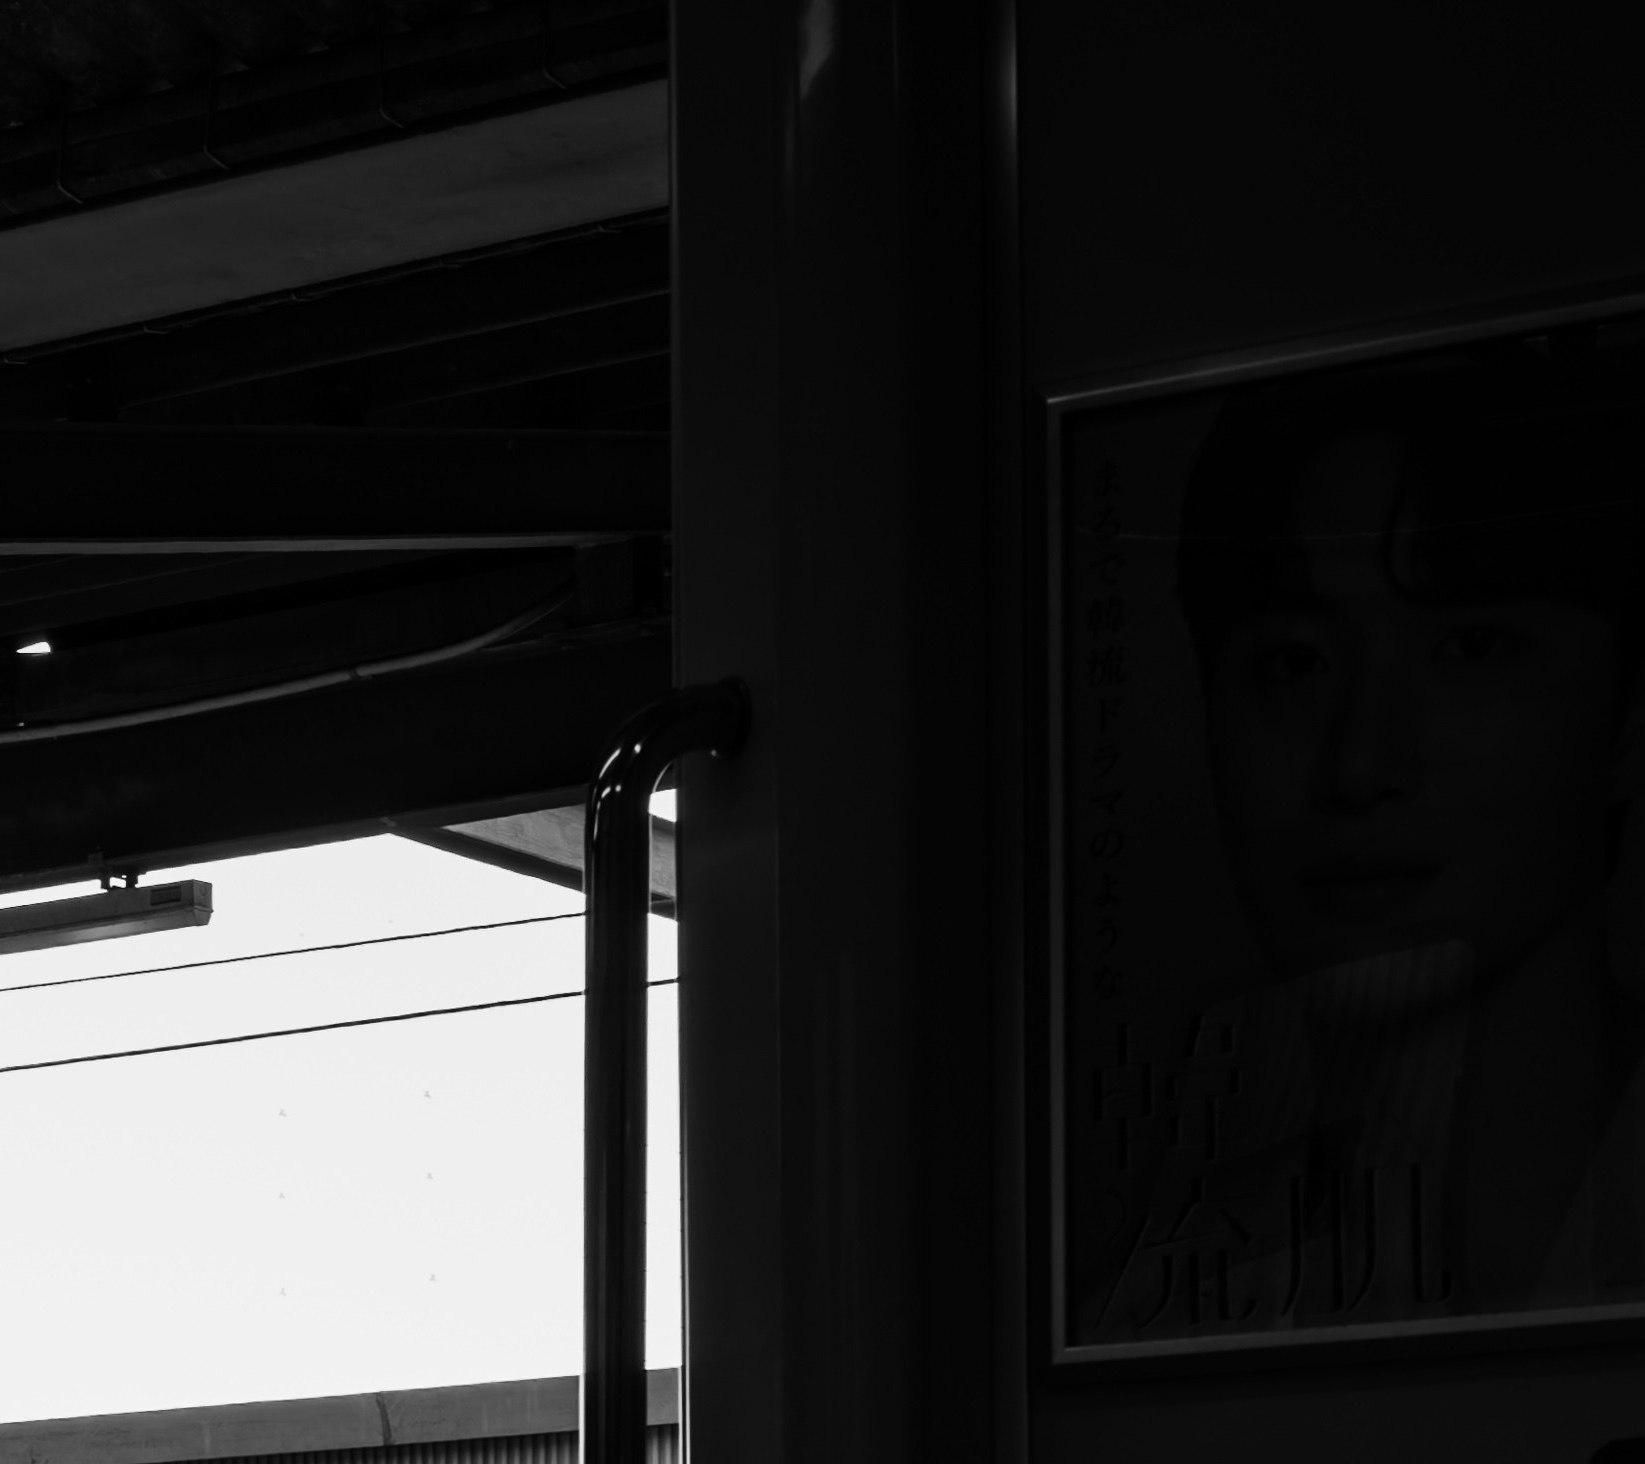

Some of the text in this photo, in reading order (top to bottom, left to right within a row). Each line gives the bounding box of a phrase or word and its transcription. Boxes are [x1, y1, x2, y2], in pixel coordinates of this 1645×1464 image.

[1086, 460, 1126, 1000] まるで韓流ドラマのような
